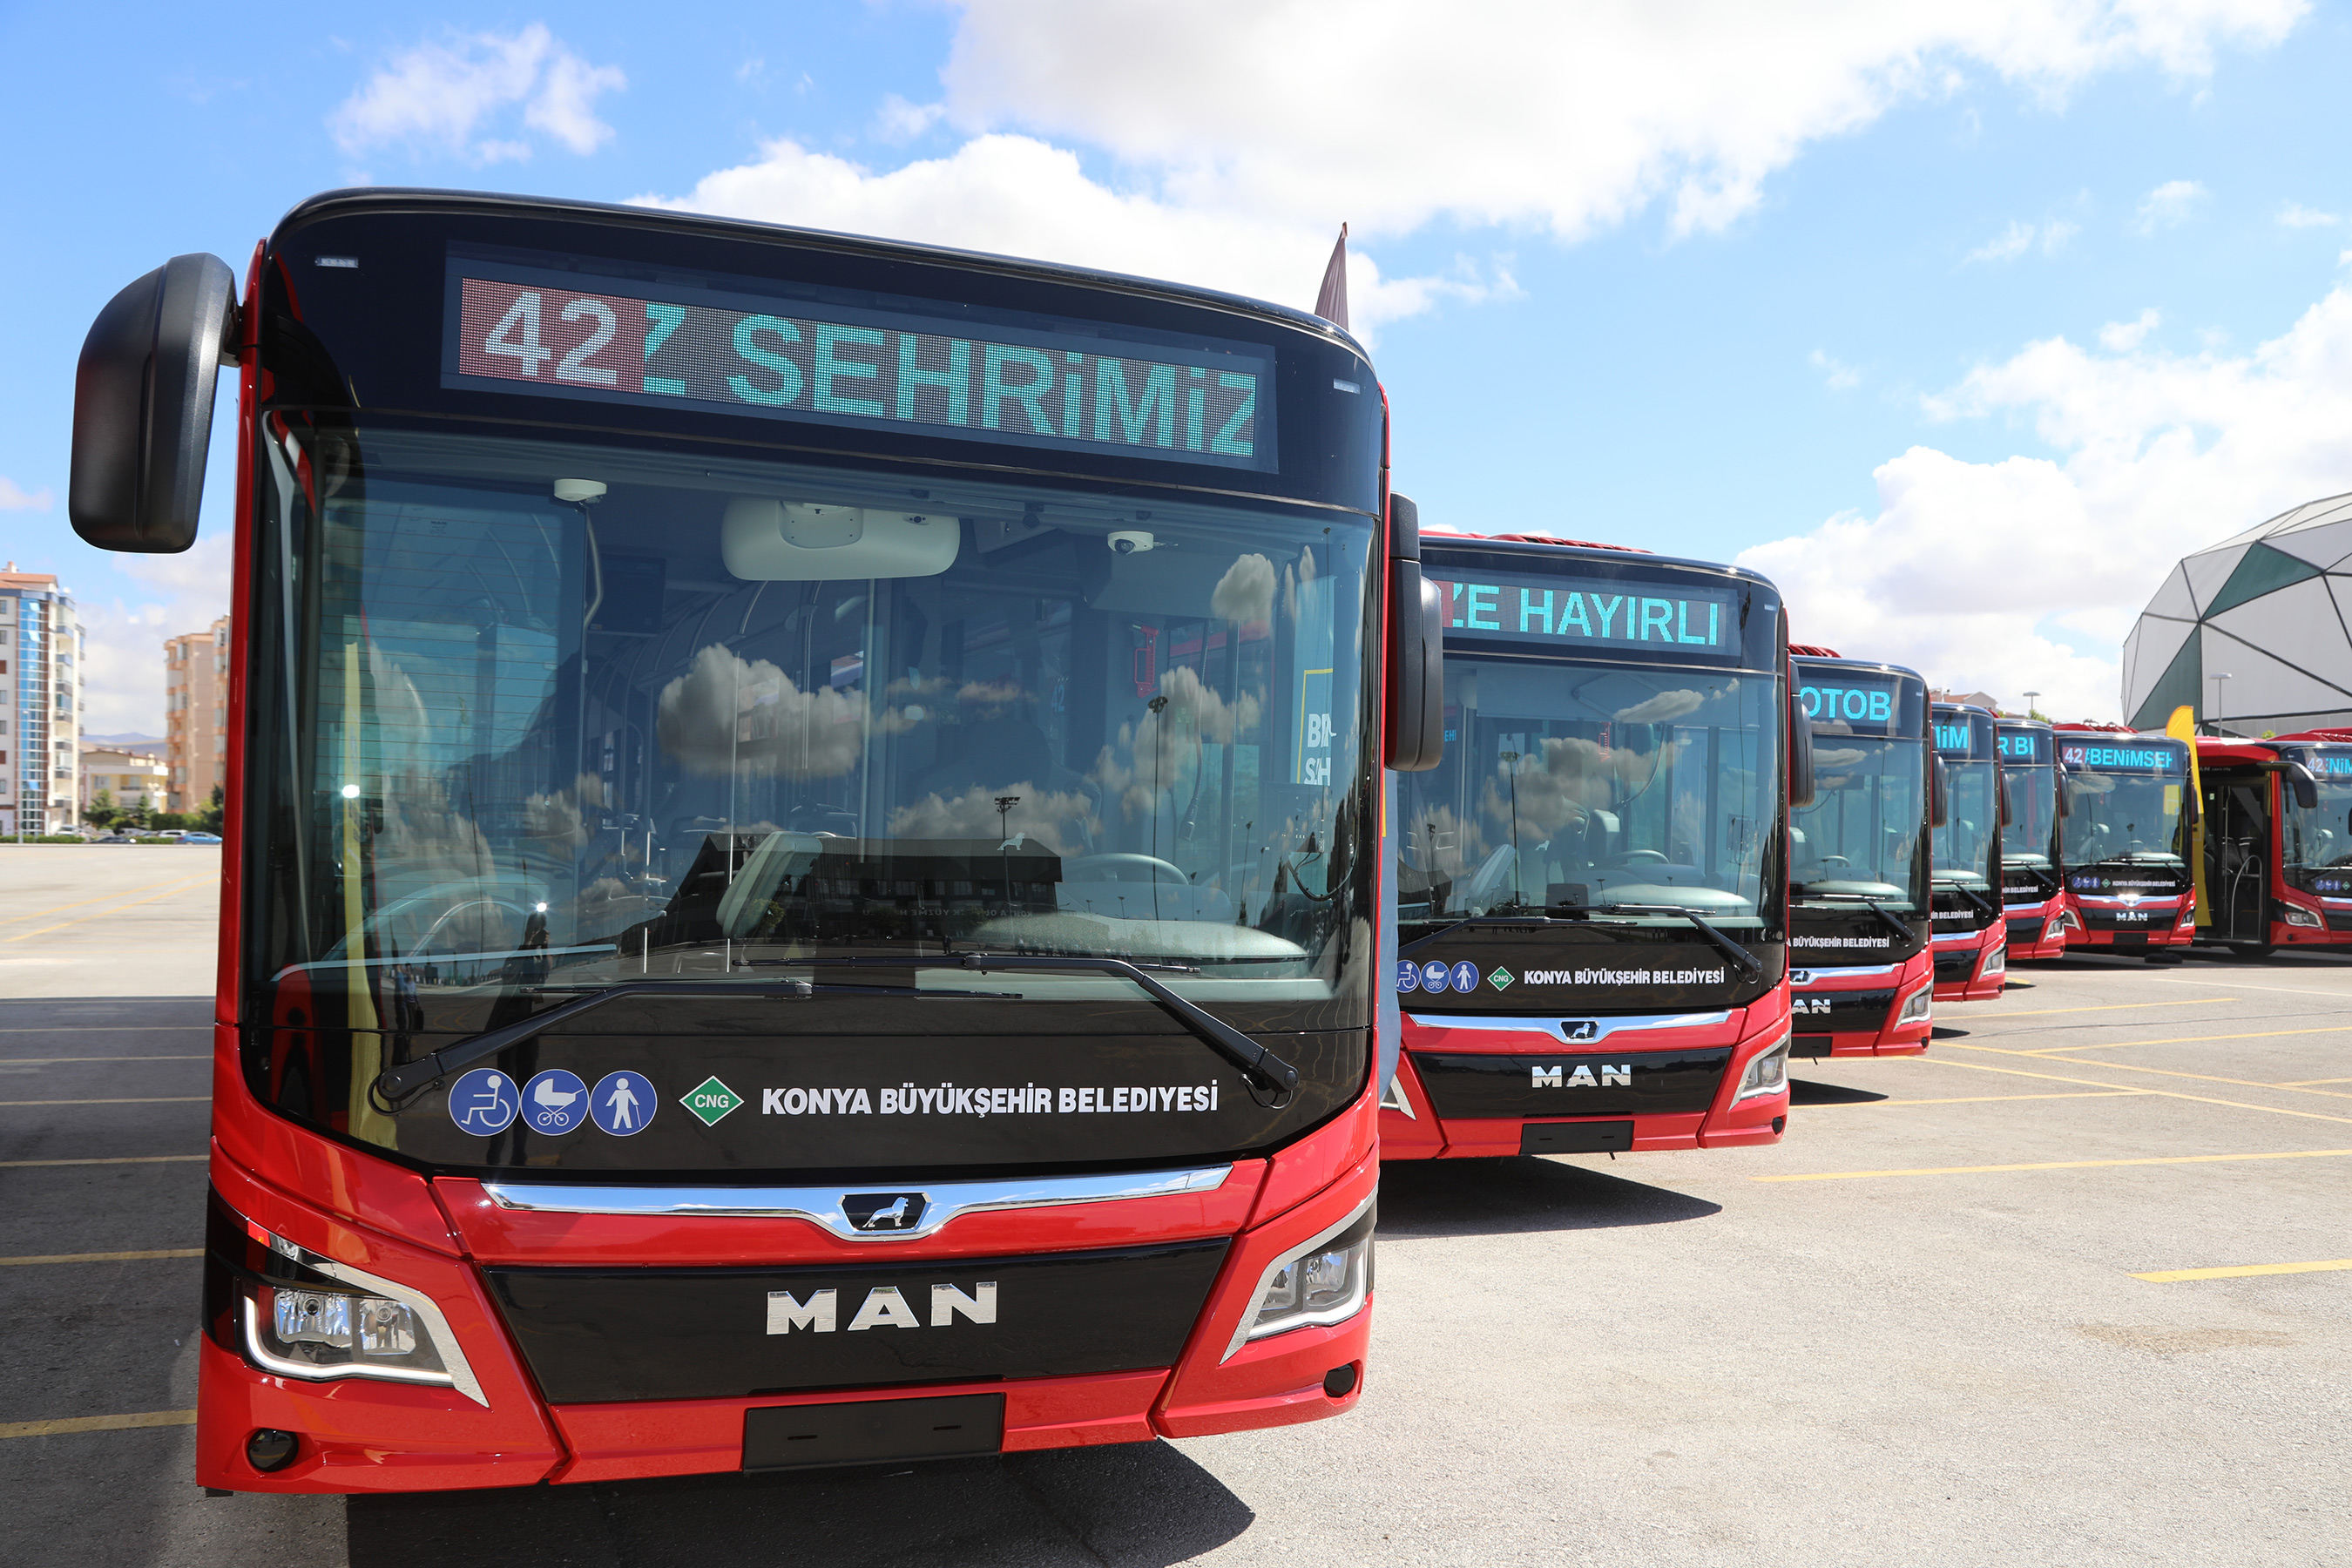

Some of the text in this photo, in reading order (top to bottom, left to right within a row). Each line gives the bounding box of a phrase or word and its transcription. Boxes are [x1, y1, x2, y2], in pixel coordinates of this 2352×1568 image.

[484, 291, 618, 385] 42
[1519, 588, 1718, 645] HAYIRLI
[1800, 686, 1892, 721] OTOB
[2065, 747, 2083, 763] 42
[2307, 757, 2324, 773] 42
[2116, 912, 2148, 922] MAN
[1793, 936, 1842, 949] BÜYÜKŞEHİR
[1842, 936, 1889, 948] BELEDİYESİ
[1524, 966, 1726, 987] KONYA BÜYÜKŞEHİR BELEDİYESİ
[1791, 998, 1831, 1014] AN
[1531, 1064, 1632, 1089] MAN
[694, 1094, 729, 1108] CNG
[761, 1088, 873, 1115] KONYA
[879, 1082, 1052, 1119] BÜYÜKŞEHİR
[767, 1281, 997, 1335] MAN
